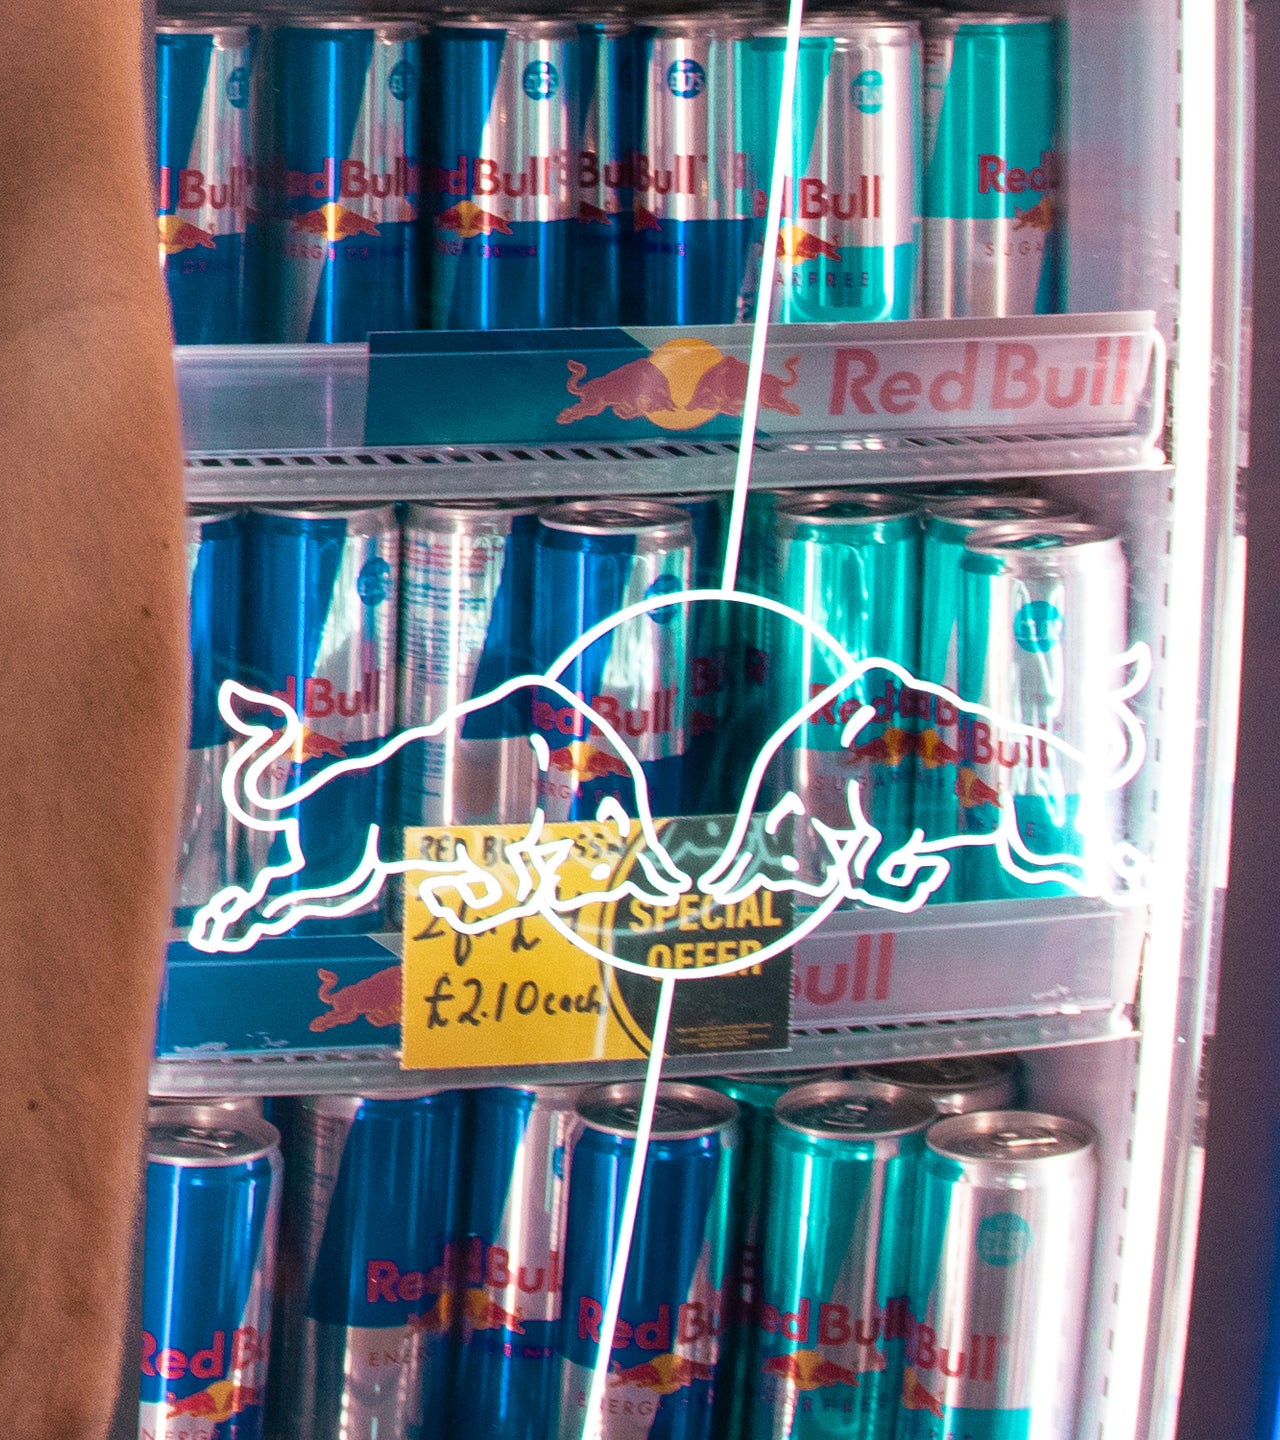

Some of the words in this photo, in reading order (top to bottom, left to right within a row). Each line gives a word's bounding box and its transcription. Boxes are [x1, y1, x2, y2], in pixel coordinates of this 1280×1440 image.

[340, 156, 407, 200] Bull
[473, 154, 552, 199] Bull
[800, 174, 882, 221] Bull
[977, 152, 1058, 194] Red
[827, 341, 980, 418] Red
[990, 335, 1131, 413] Bull
[304, 670, 380, 719] Bull
[590, 685, 676, 738] Bull
[628, 889, 783, 932] SPECIAL
[647, 939, 763, 981] OFFER
[791, 932, 894, 1007] ull
[424, 975, 539, 1030] £2.10
[578, 1295, 672, 1351] Red
[140, 1329, 225, 1379] Red
[915, 1323, 999, 1381] Bull
